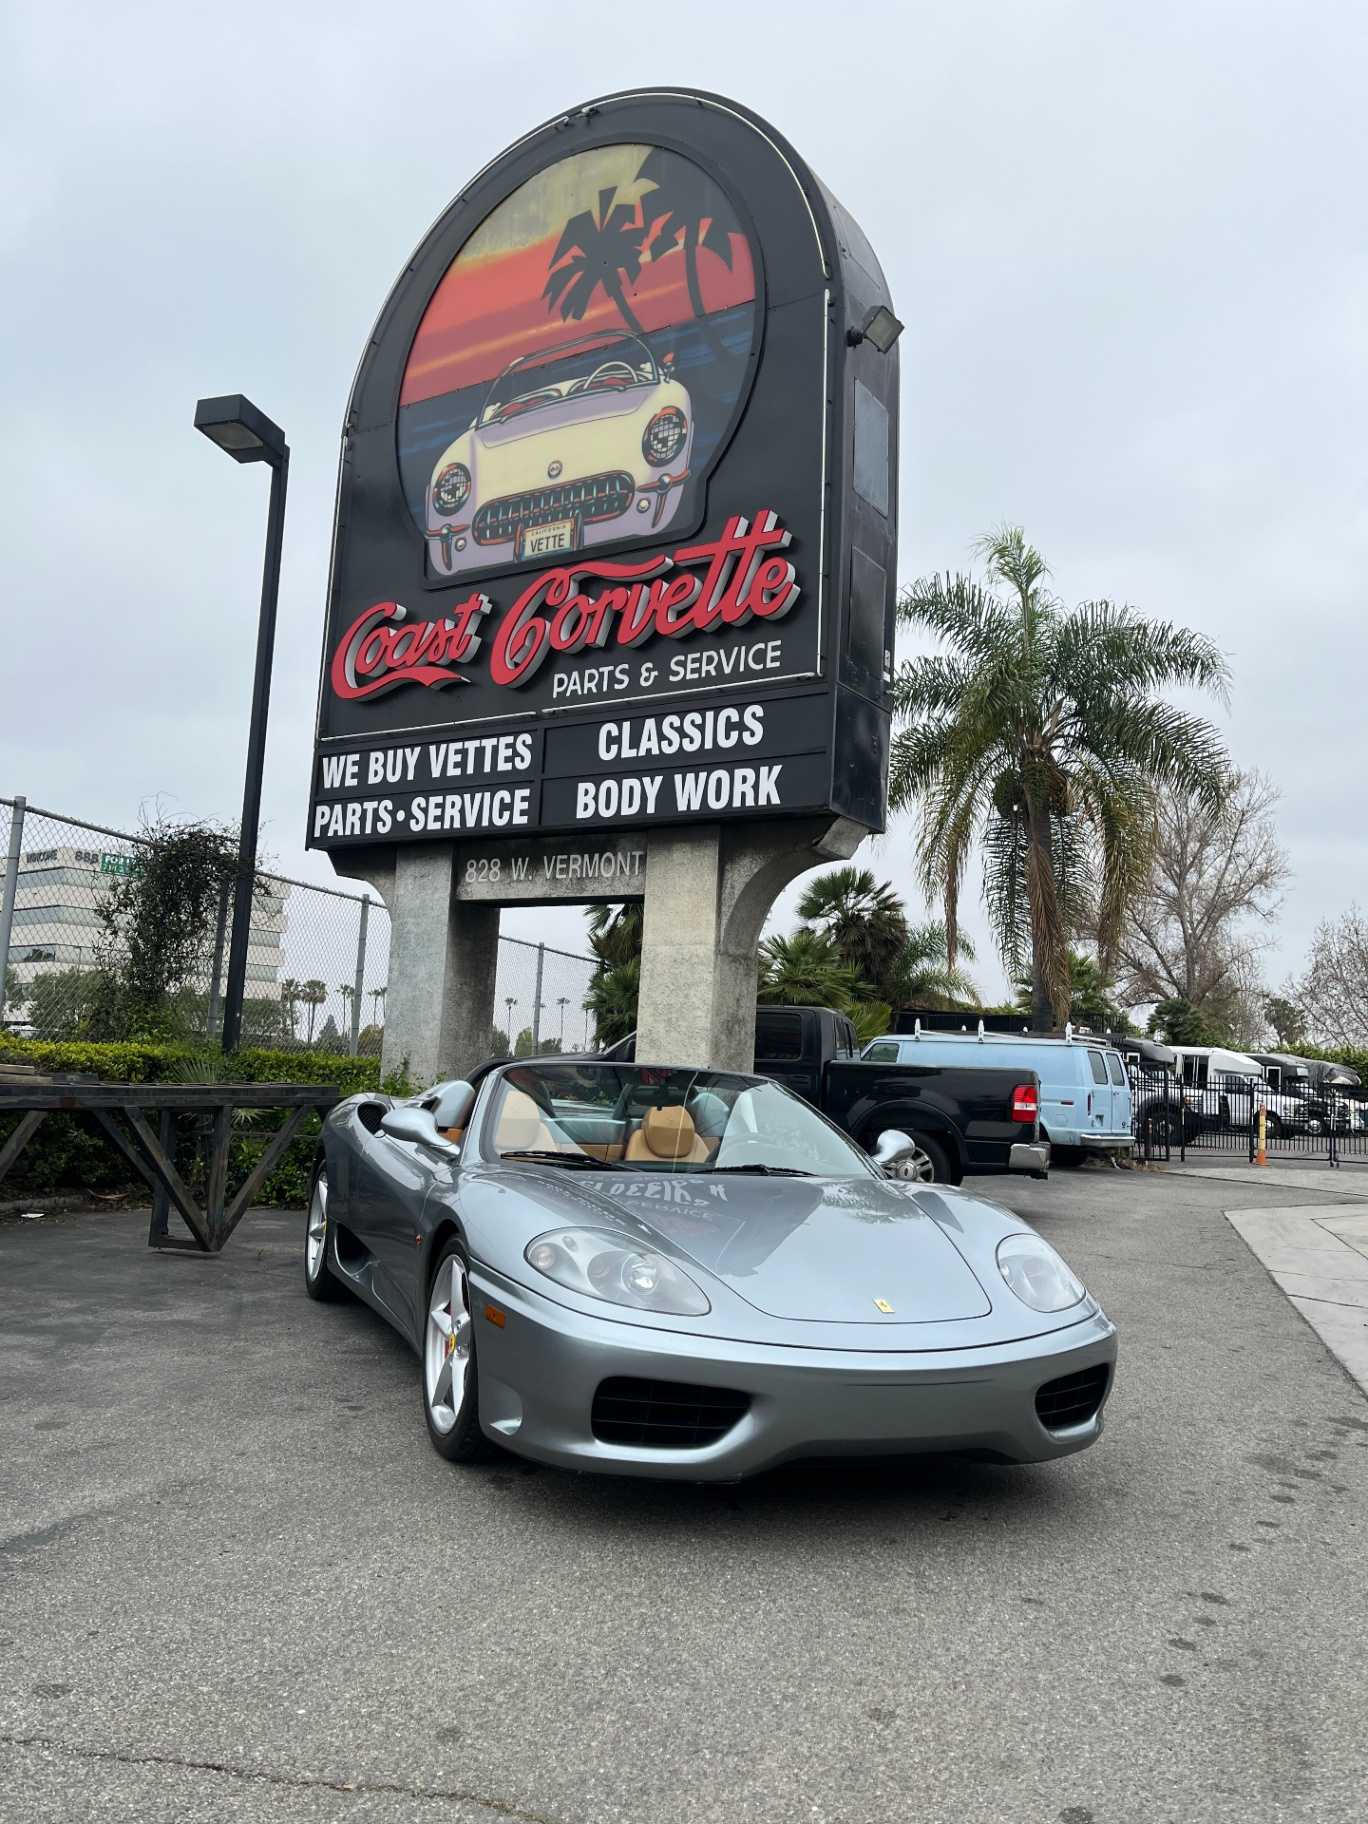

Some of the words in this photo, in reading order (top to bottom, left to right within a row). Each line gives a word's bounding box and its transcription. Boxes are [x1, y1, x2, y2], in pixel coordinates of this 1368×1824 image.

[530, 533, 565, 552] VETTE
[331, 592, 493, 701] Coast
[490, 509, 800, 688] Corvette
[552, 663, 630, 698] PARTS
[639, 662, 659, 687] &
[669, 640, 783, 682] SERVICE
[598, 704, 764, 761] CLASSICS
[322, 753, 360, 789] WE
[367, 746, 421, 785] BUY
[429, 733, 532, 778] VETTES
[576, 775, 664, 819] BODY
[674, 764, 783, 812] WORK
[465, 858, 501, 883] 828
[511, 857, 533, 881] W.
[543, 851, 645, 880] VERMONT
